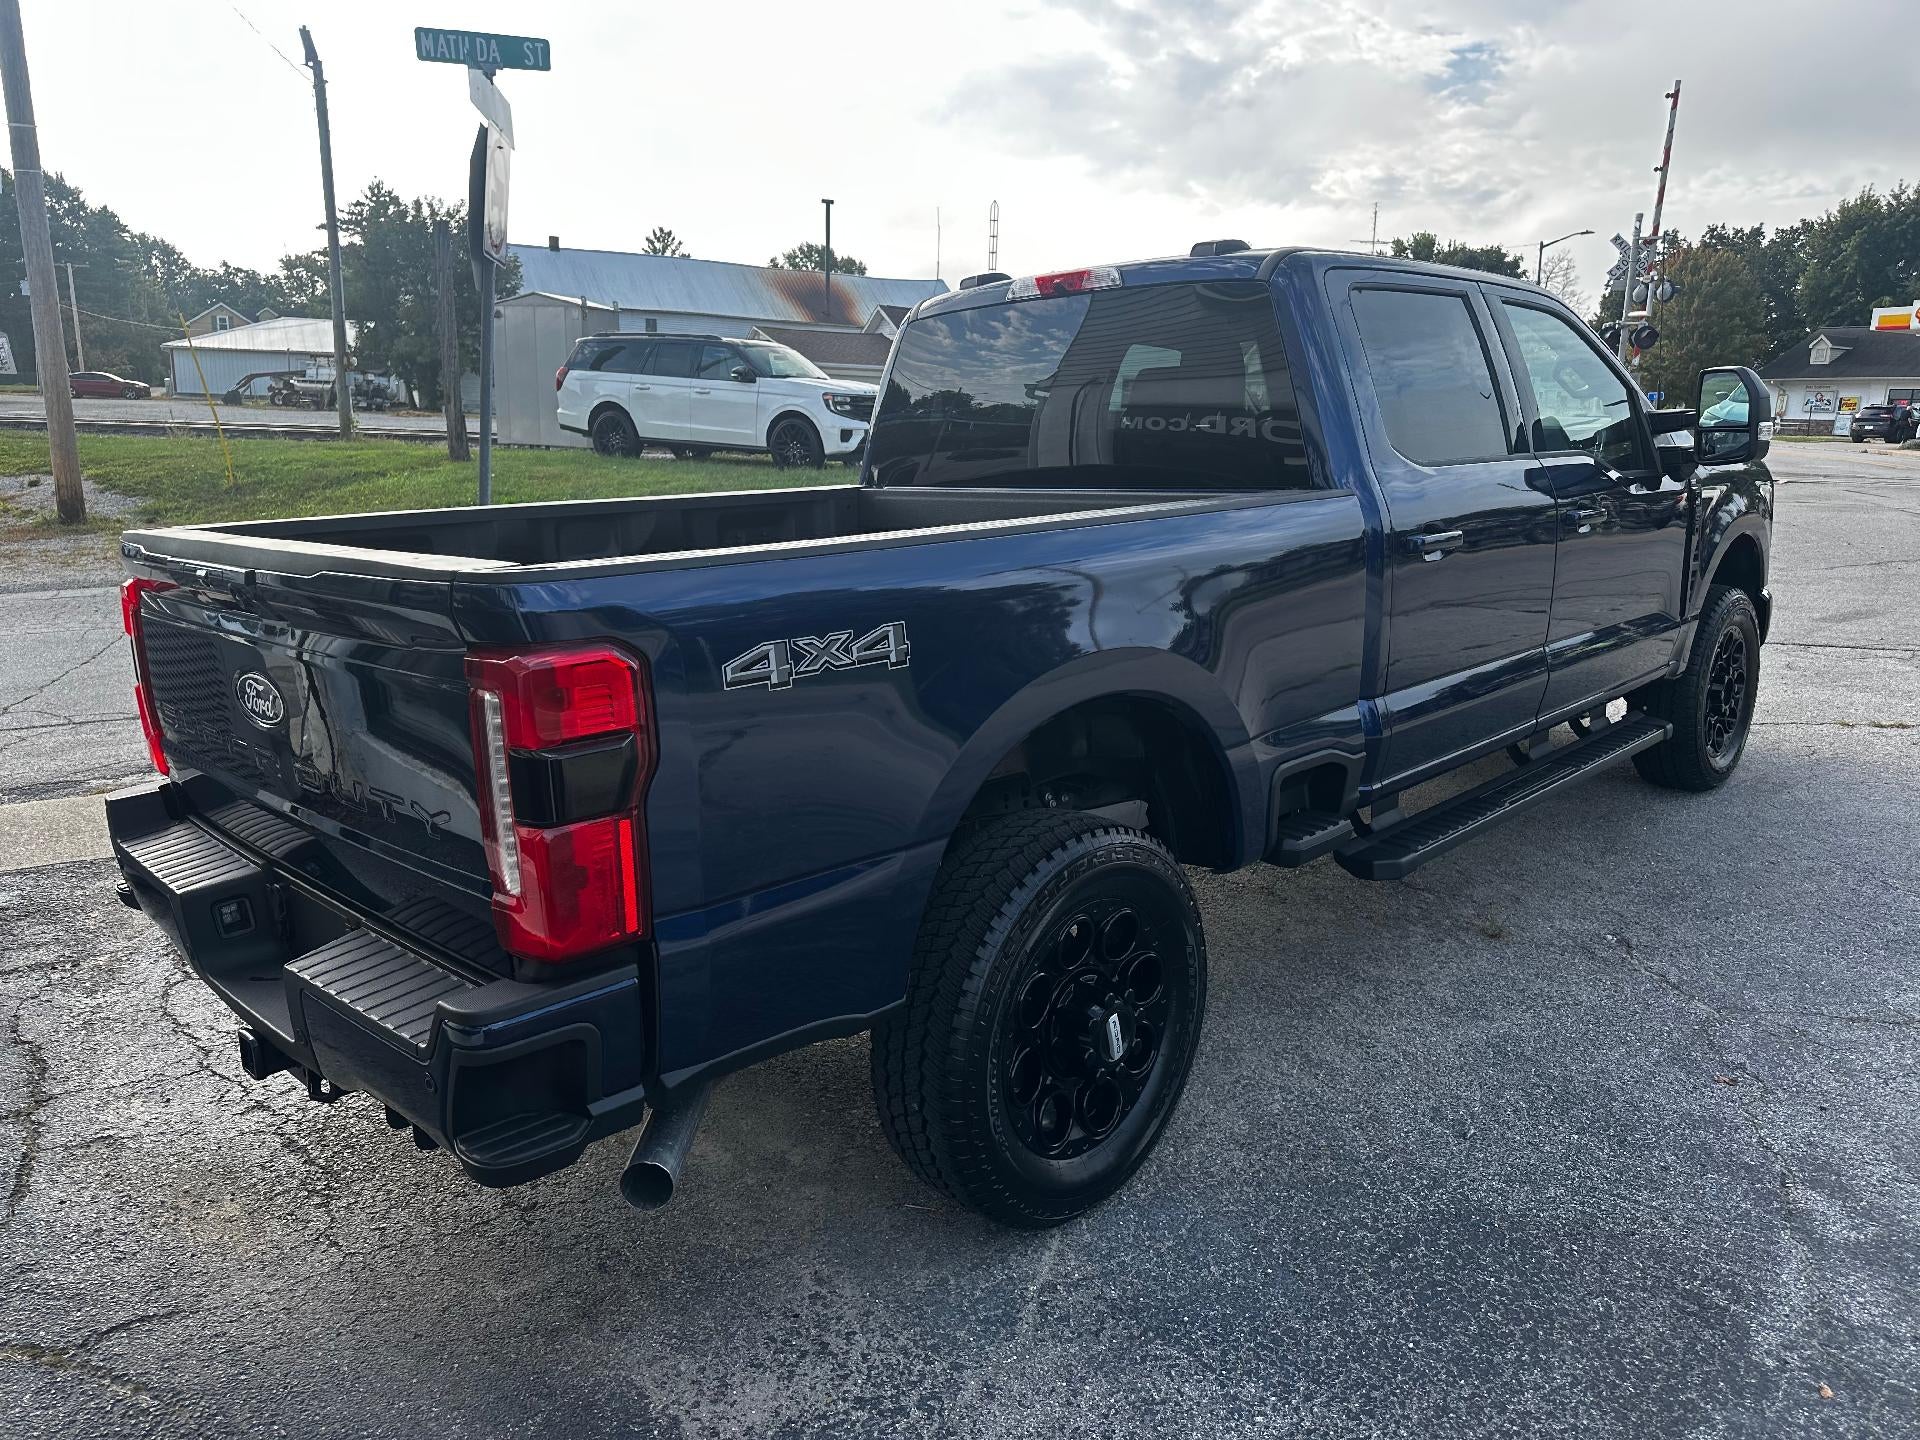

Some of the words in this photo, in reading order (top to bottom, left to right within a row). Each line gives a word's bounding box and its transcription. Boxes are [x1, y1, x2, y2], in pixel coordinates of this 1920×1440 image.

[523, 42, 544, 66] ST
[245, 680, 275, 718] Ford
[292, 761, 451, 840] DUTY
